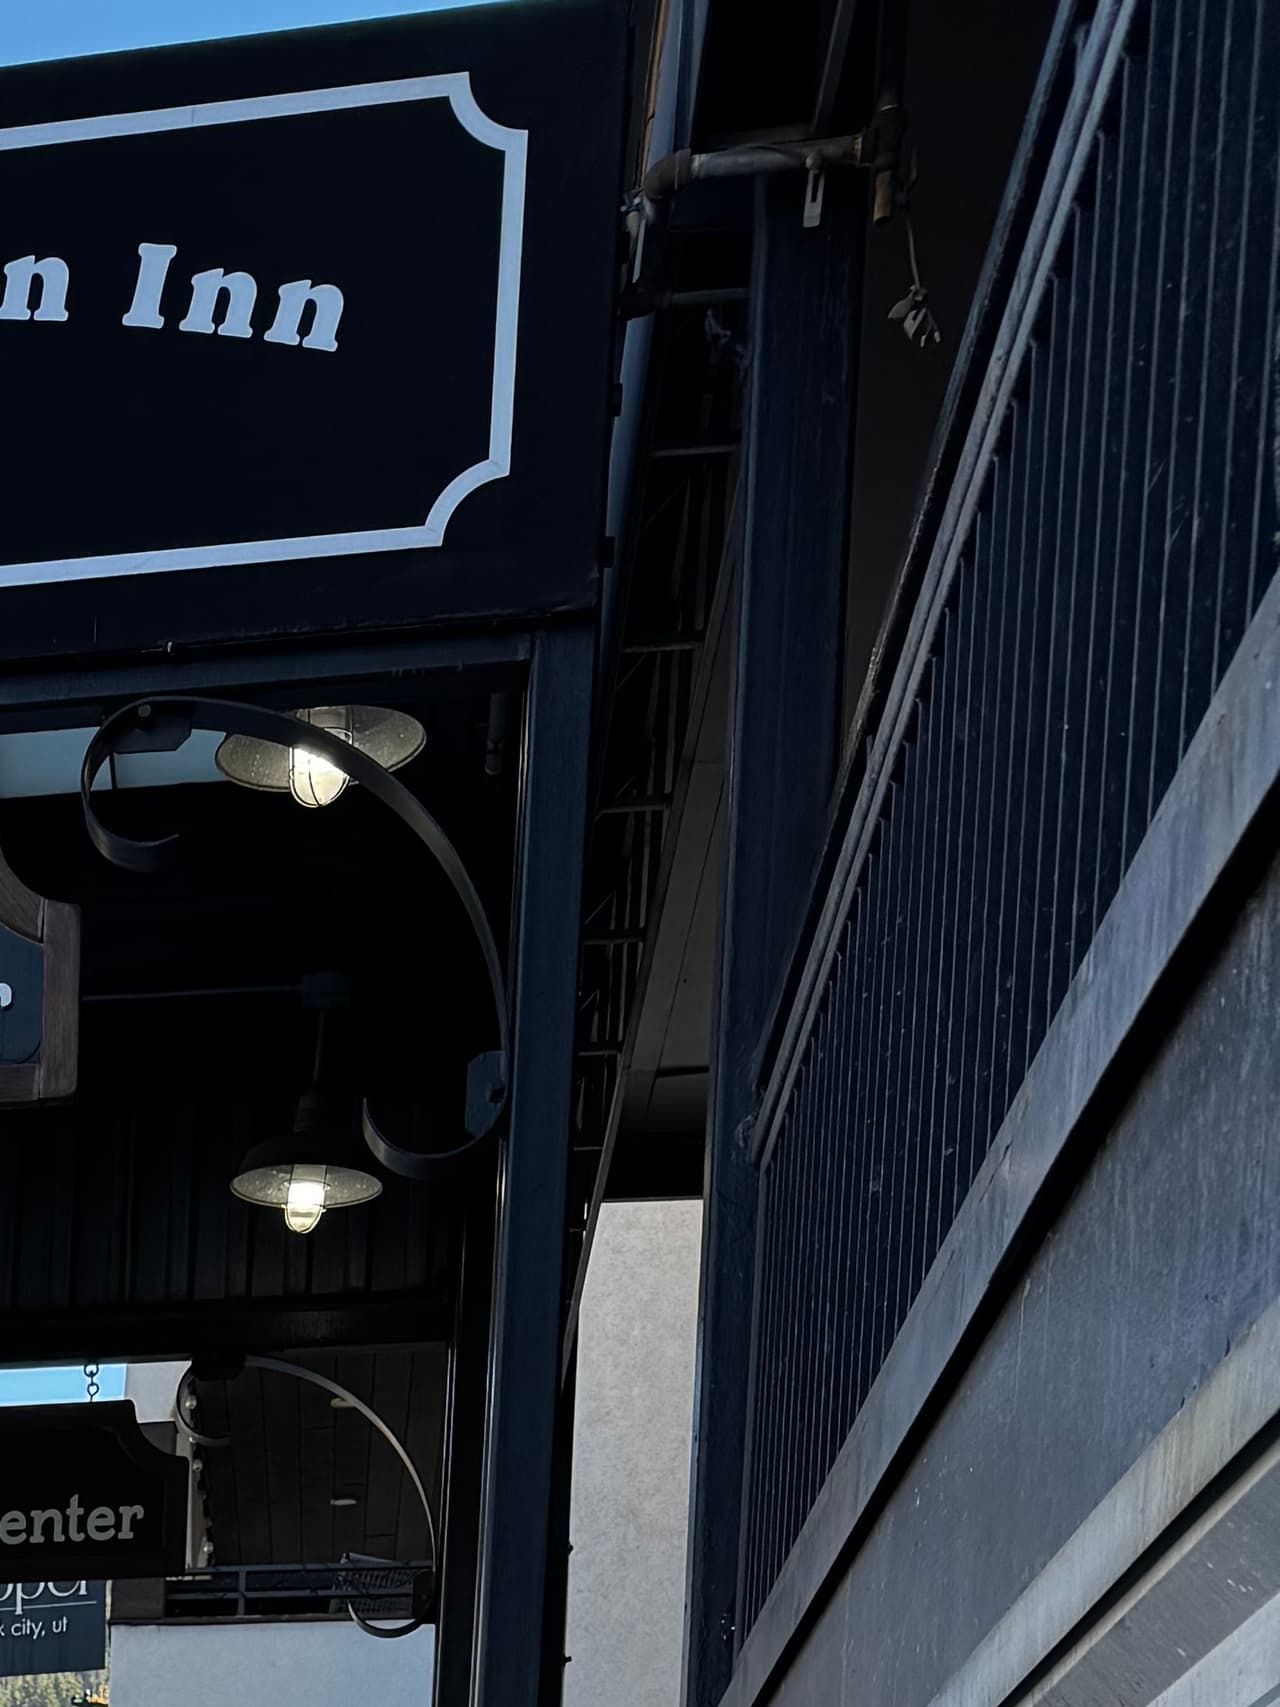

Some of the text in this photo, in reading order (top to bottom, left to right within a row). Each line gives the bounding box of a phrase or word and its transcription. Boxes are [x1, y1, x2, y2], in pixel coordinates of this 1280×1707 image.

[121, 242, 344, 352] Inn
[10, 1618, 46, 1641] city,
[52, 1616, 68, 1633] ut
